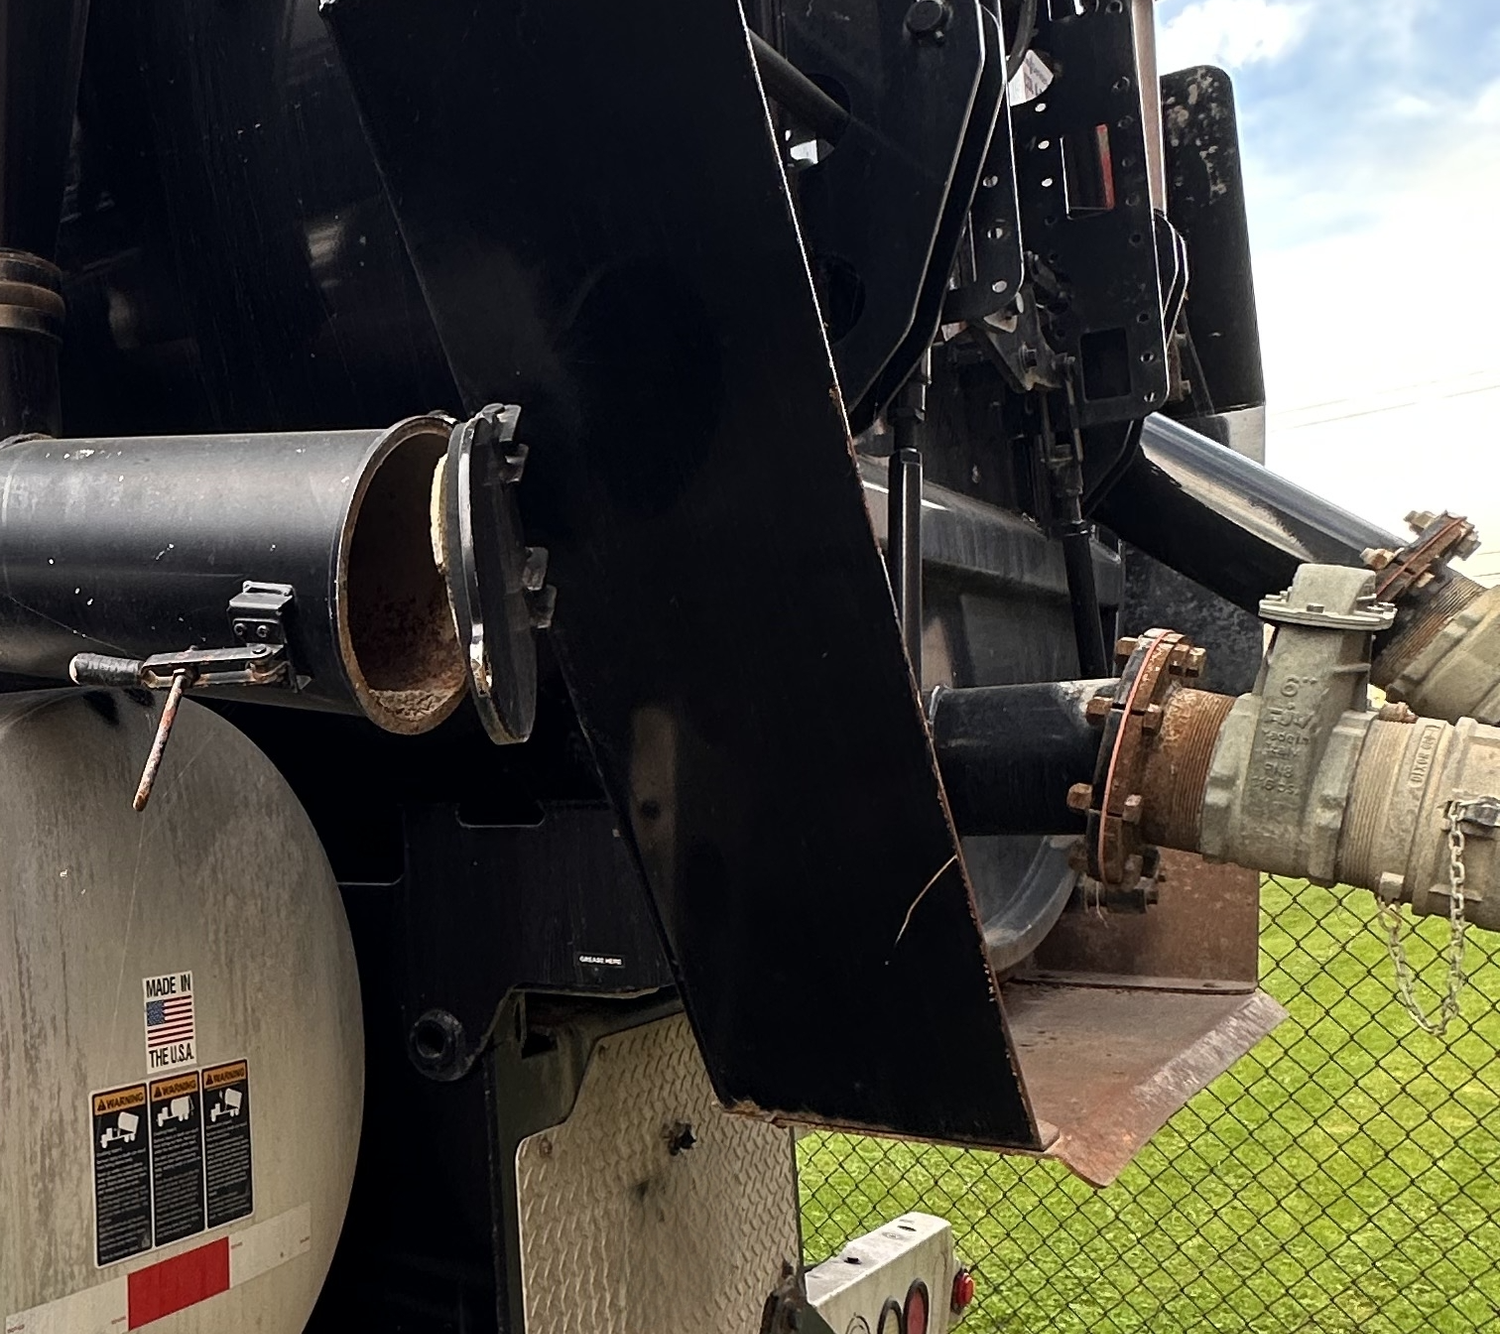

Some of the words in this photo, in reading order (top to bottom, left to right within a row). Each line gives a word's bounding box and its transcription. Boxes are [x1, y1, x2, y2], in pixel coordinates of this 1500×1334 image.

[146, 976, 177, 998] MADE
[181, 973, 191, 992] IN
[149, 1047, 169, 1068] THE
[213, 1067, 245, 1083] WARNING
[161, 1080, 196, 1096] WARNING
[105, 1092, 144, 1109] WARNING
